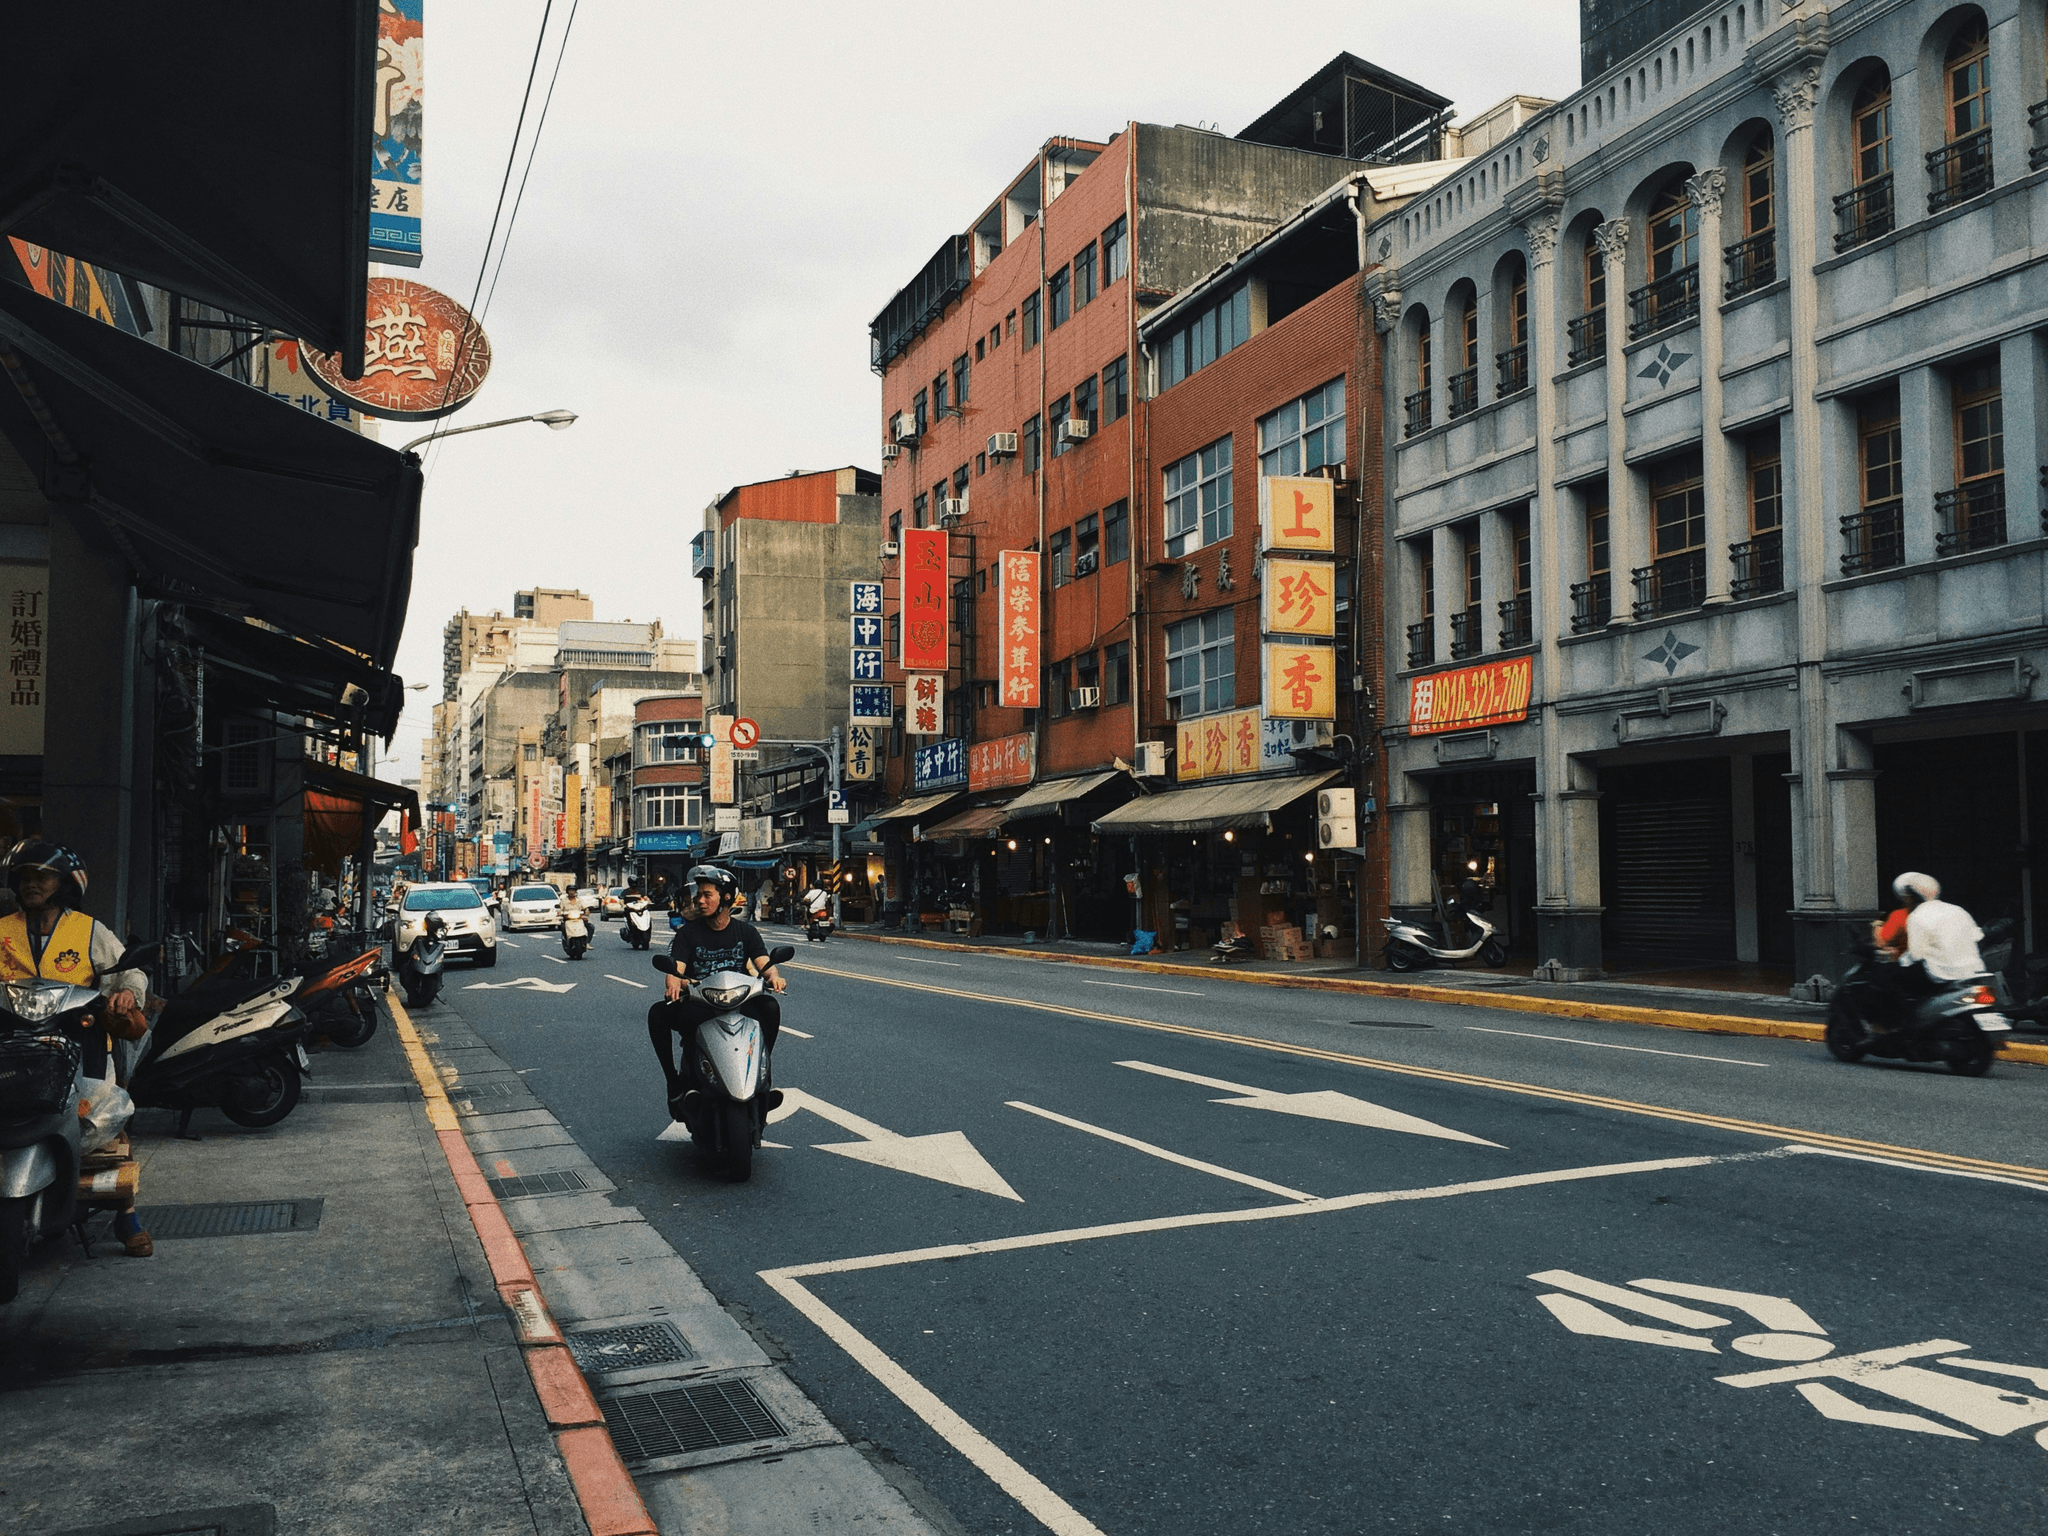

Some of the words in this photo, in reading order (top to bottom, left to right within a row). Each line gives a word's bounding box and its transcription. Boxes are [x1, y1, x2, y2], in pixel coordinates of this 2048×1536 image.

[912, 540, 941, 613] 玉山
[1281, 490, 1328, 712] 上珍香
[10, 589, 44, 706] 訂婚禮品
[855, 585, 881, 679] 海中行
[1414, 680, 1434, 723] 租
[1432, 662, 1528, 730] 0910-321-700
[849, 727, 873, 775] 松青
[922, 741, 958, 779] 海中行
[981, 739, 1015, 774] 玉山行
[1180, 715, 1255, 771] 上珍香
[829, 790, 841, 810] P
